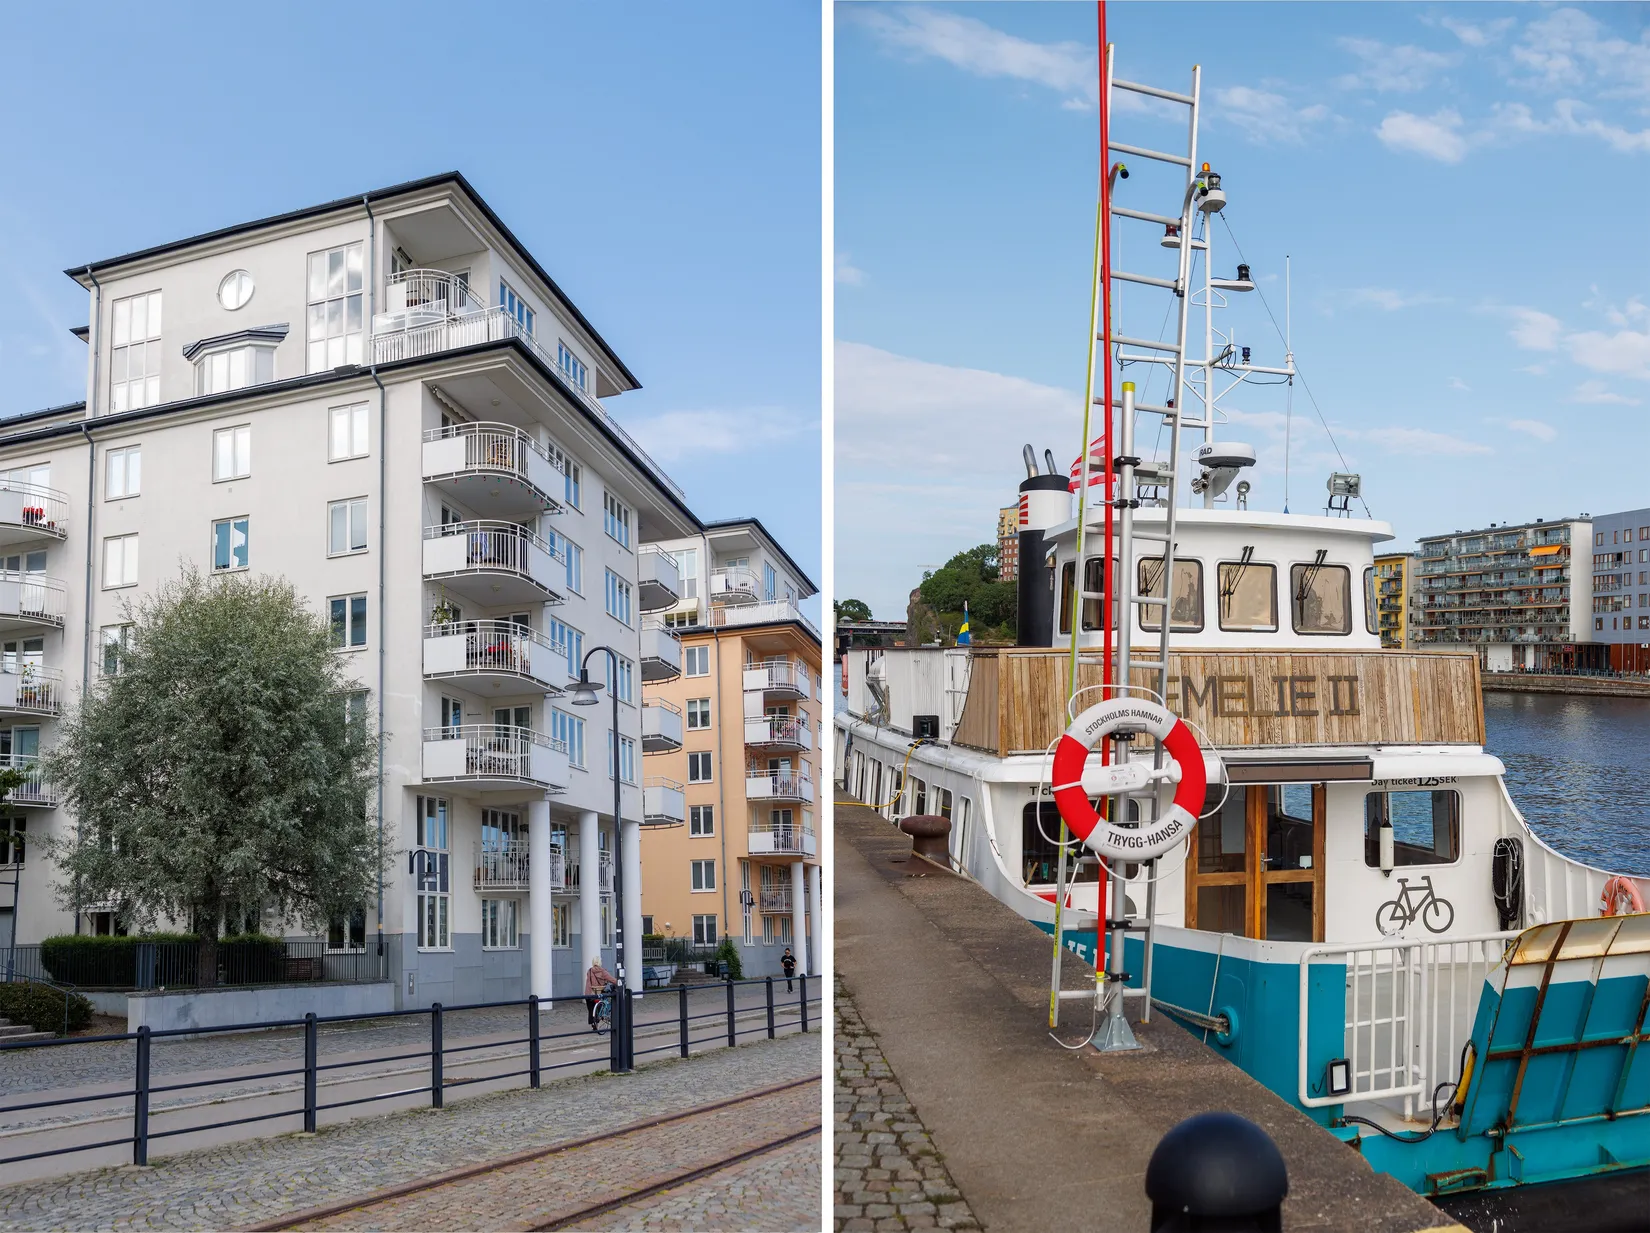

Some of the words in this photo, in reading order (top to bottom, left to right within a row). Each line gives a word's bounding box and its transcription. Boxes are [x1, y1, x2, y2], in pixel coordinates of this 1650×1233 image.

[1151, 675, 1319, 717] EMELIE
[1085, 709, 1130, 736] STOCKHOLMS
[1131, 709, 1163, 725] HAMNAR
[1107, 819, 1183, 849] TRYGG-HANSA
